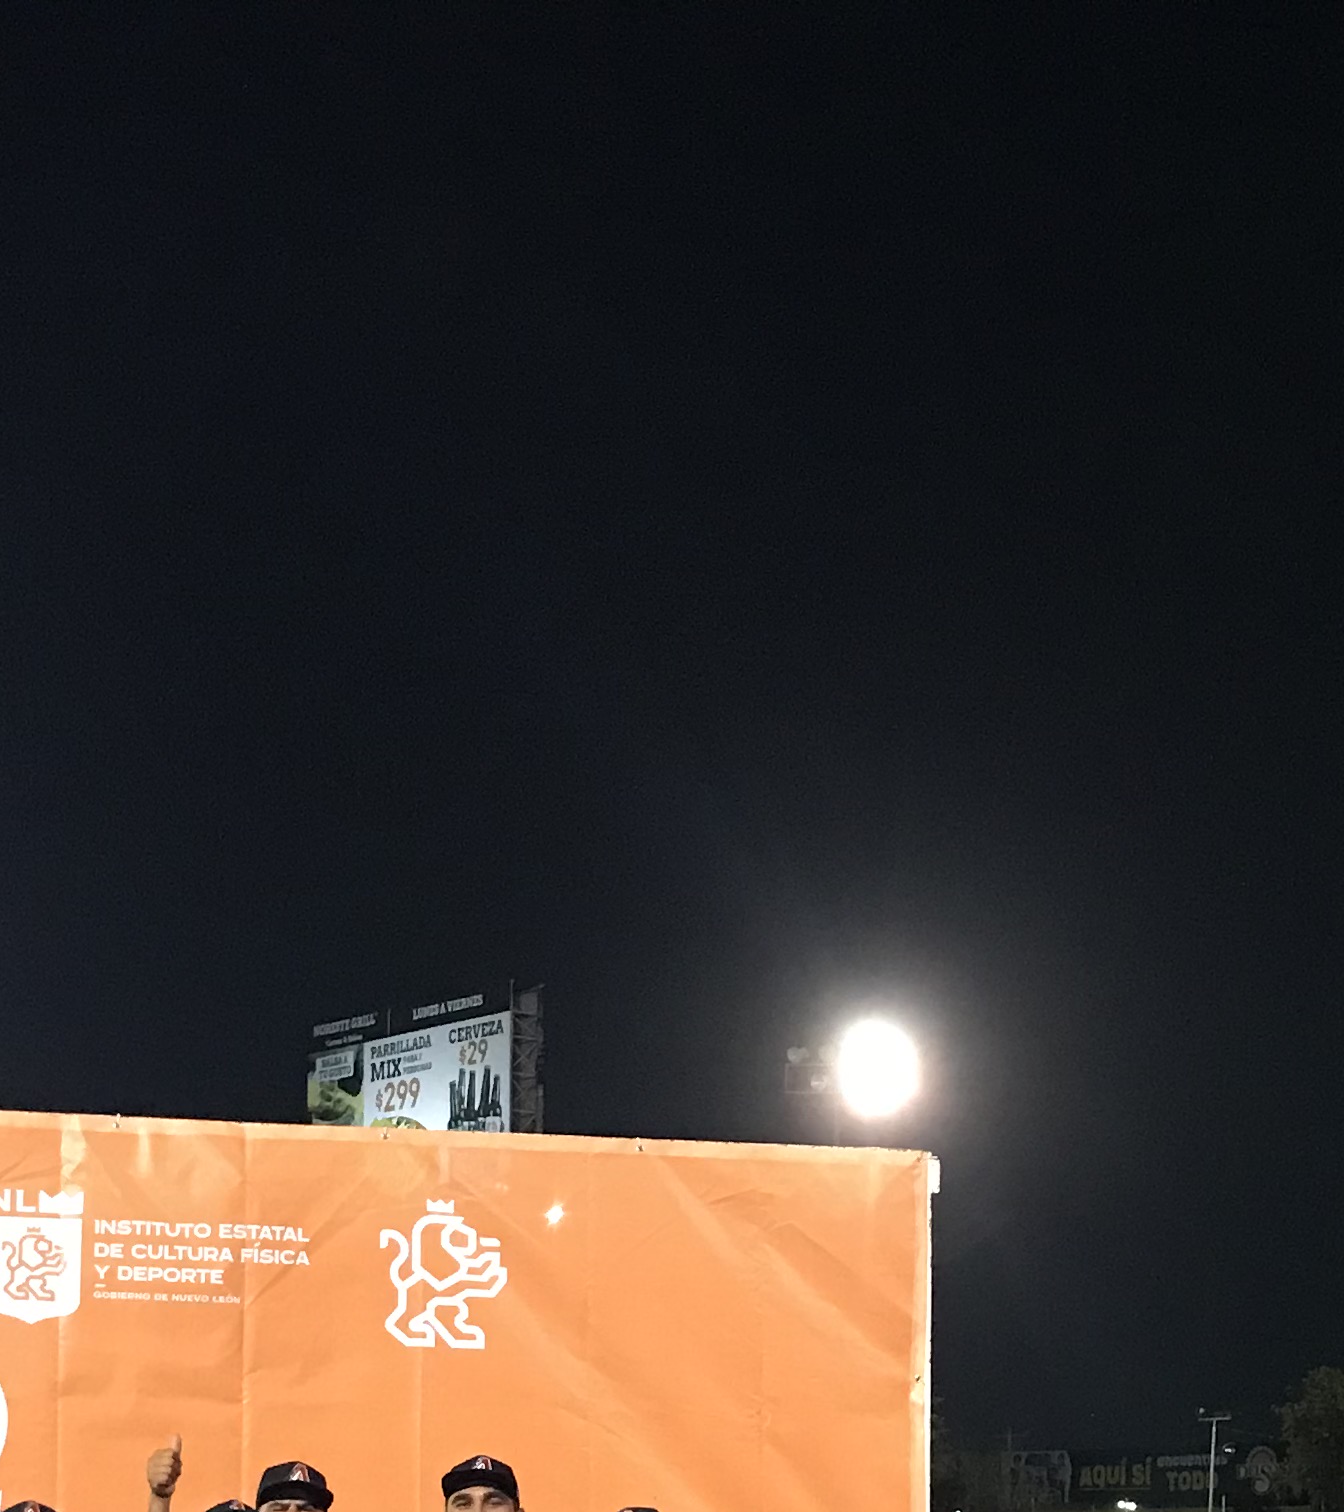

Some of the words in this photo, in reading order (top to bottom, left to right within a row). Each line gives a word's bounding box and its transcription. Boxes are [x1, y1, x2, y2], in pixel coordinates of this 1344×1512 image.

[448, 1019, 504, 1044] CERVEZA
[370, 1034, 432, 1059] PARRILLADA
[458, 1038, 488, 1066] $29
[370, 1057, 401, 1082] MIX
[375, 1077, 420, 1113] $299
[94, 1219, 212, 1239] INSTITUTO
[218, 1223, 310, 1243] ESTATAL
[93, 1242, 125, 1259] DE
[130, 1243, 233, 1263] CULTURA
[240, 1242, 311, 1266] FÍSICA
[94, 1265, 111, 1280] Y
[117, 1266, 224, 1285] DEPORTE
[93, 1290, 150, 1301] GOBIERNO
[154, 1292, 168, 1301] DE
[172, 1293, 209, 1303] NUEVO
